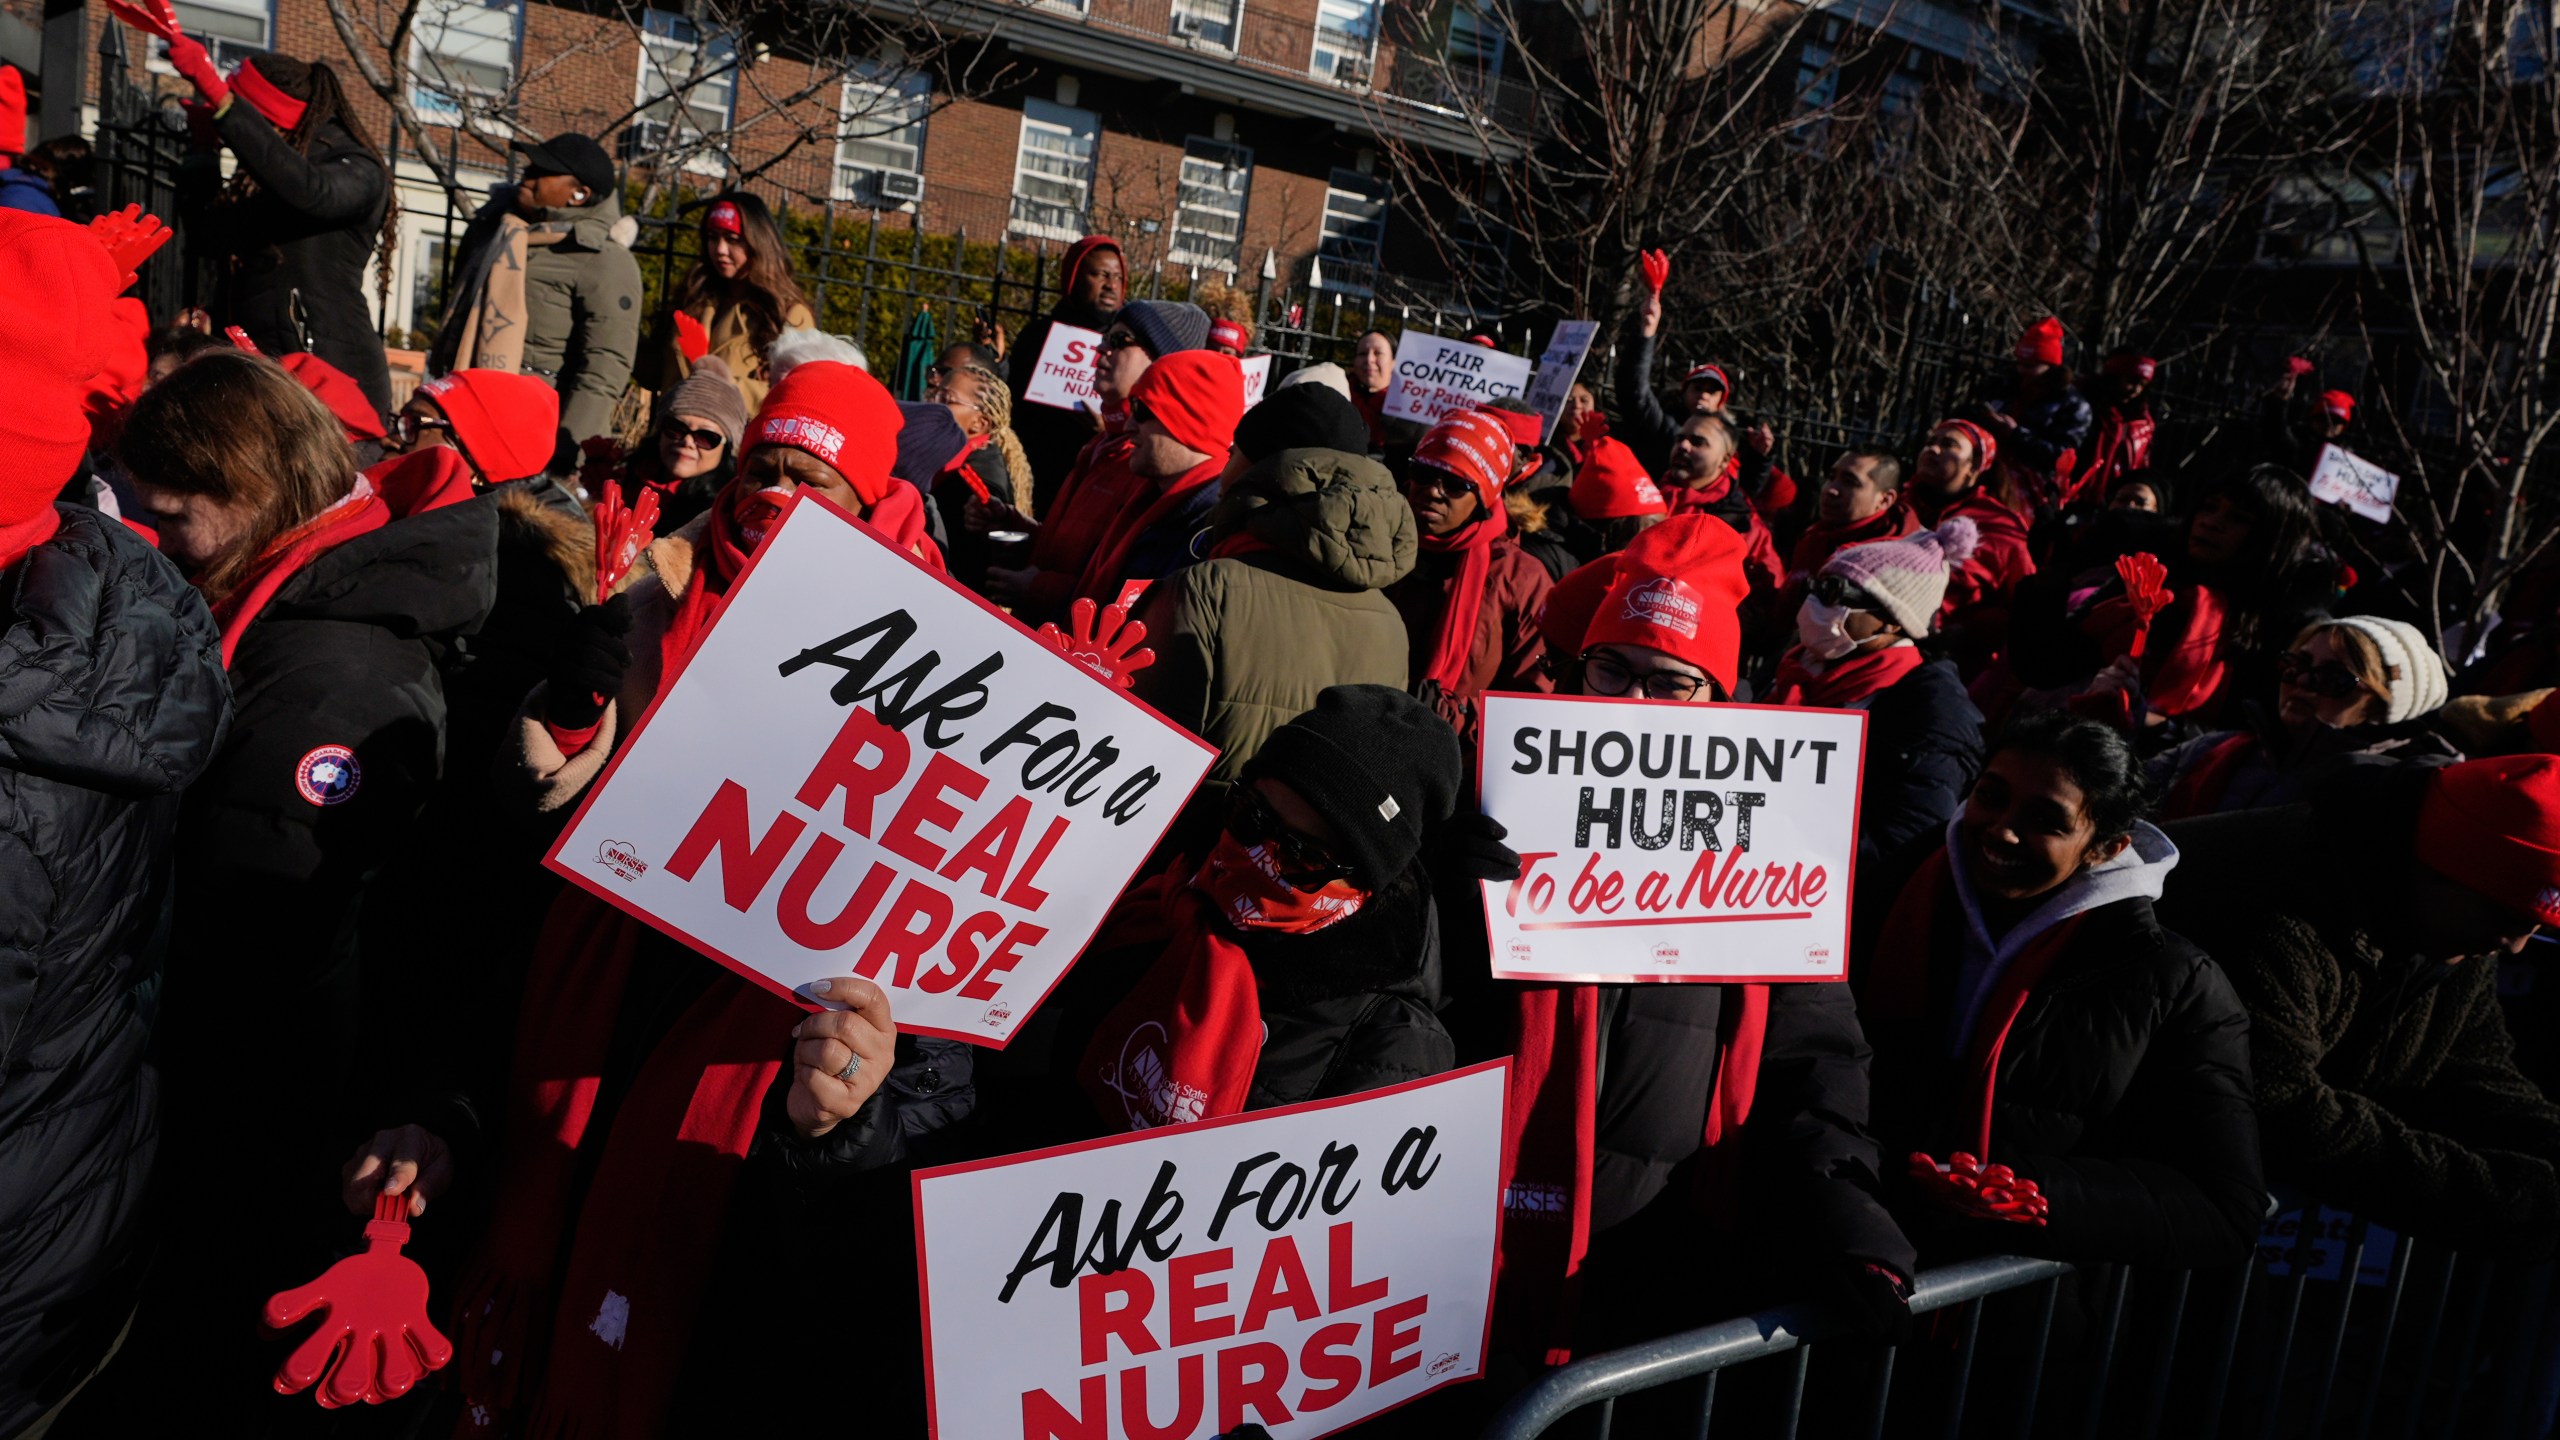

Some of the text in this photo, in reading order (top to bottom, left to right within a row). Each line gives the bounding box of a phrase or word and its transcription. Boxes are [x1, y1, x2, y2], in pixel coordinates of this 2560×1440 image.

[1399, 361, 1520, 398] CONTRACT
[1401, 381, 1477, 410] For Patie
[1435, 348, 1485, 373] FAIR
[1409, 400, 1423, 414] &
[778, 608, 1161, 826] Ask For a
[1510, 726, 1838, 784] SHOULDN'T
[794, 706, 1071, 912] REAL
[1574, 786, 1767, 853] HURT
[664, 777, 1050, 1002] NURSE
[1505, 844, 1829, 919] To be a Nurse
[1182, 1085, 1208, 1102] State
[998, 1125, 1442, 1304] Ask For a
[1078, 1221, 1389, 1367] REAL
[1021, 1294, 1429, 1440] NURSE
